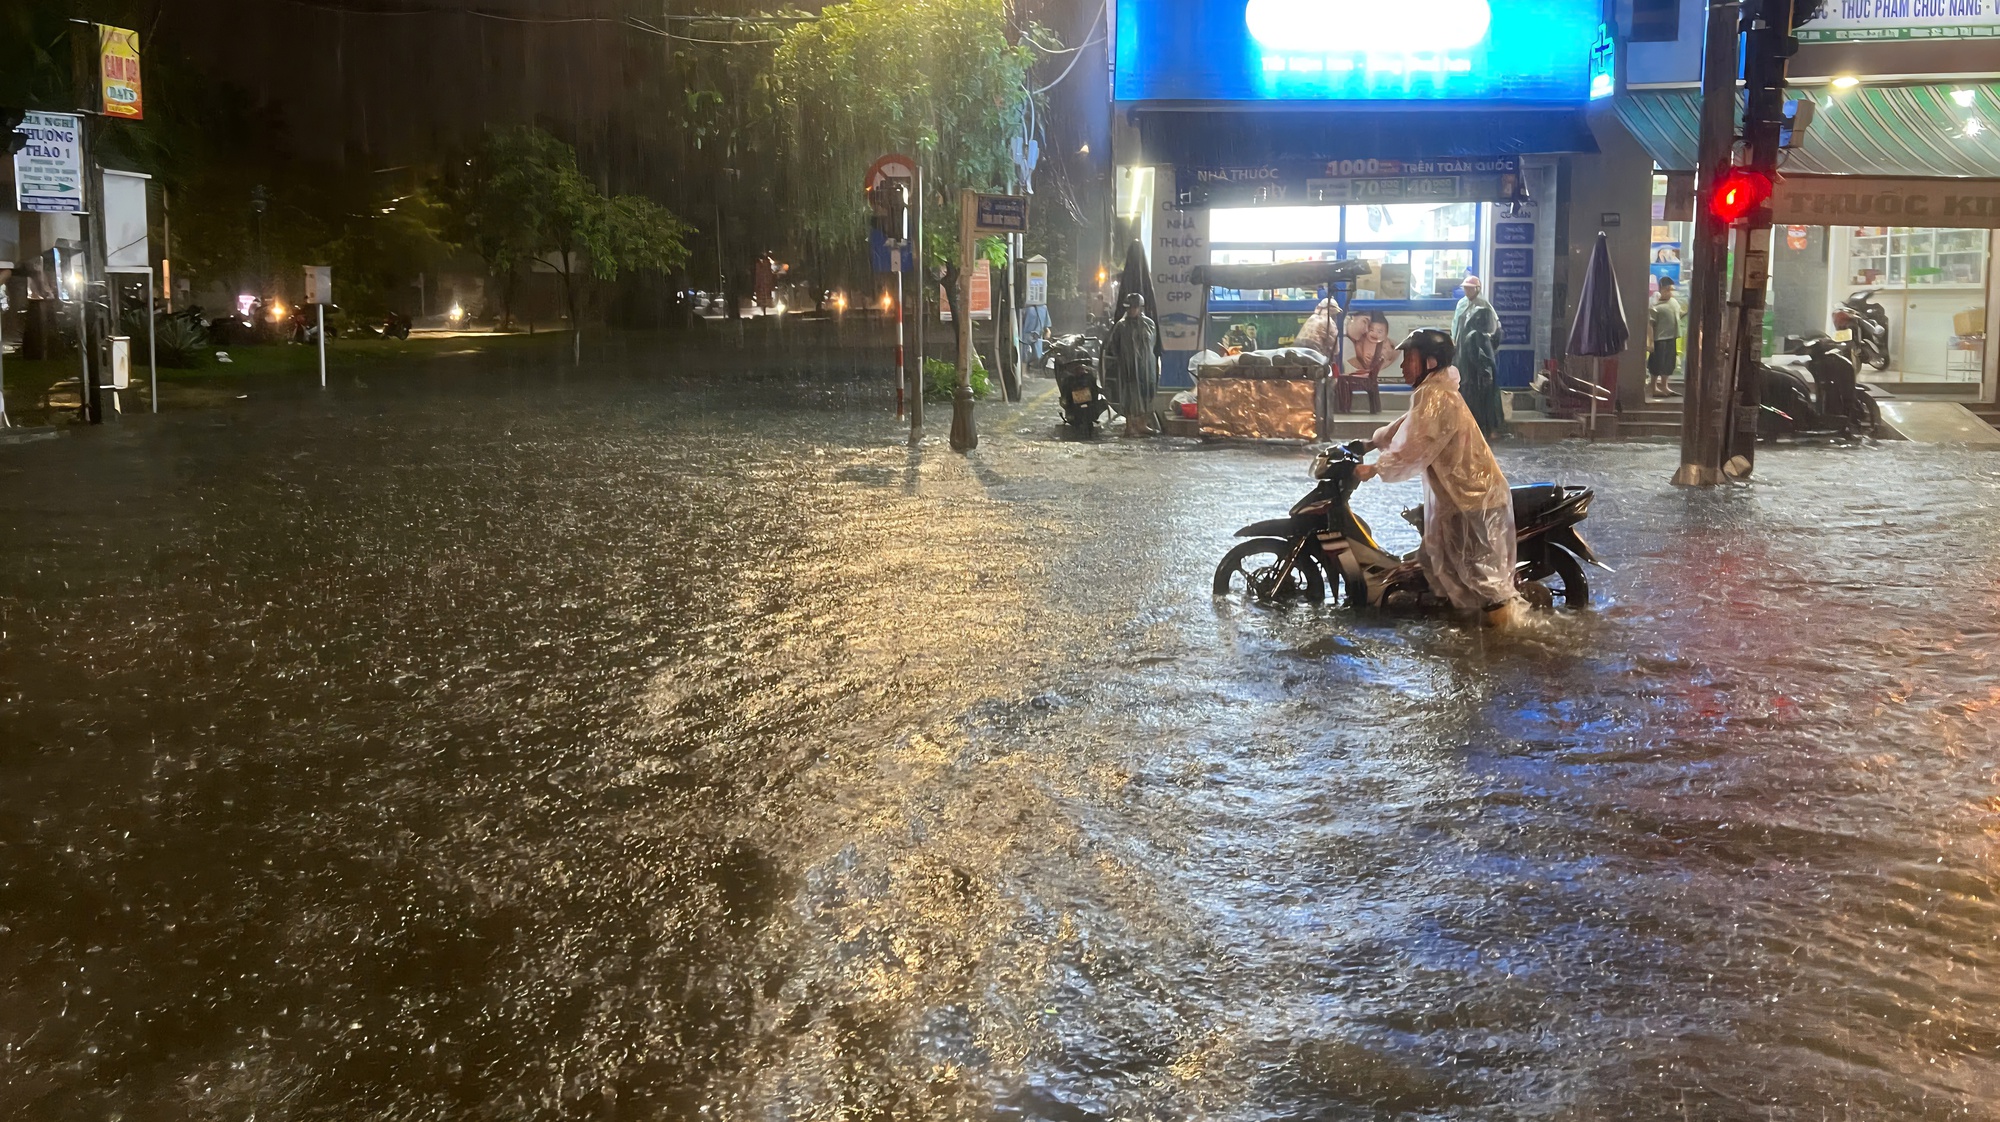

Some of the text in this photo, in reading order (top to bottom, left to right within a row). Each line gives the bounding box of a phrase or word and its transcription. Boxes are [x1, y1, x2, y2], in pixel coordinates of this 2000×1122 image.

[1197, 164, 1279, 182] NHÀ THUỐC
[1327, 158, 1379, 176] 1000
[1402, 161, 1434, 174] TRÊN
[1436, 159, 1473, 173] TOÀN
[1475, 158, 1514, 171] QUỐC
[1784, 188, 1930, 214] THUỐC
[1167, 216, 1196, 229] NHÀ
[1168, 255, 1192, 269] ĐẠT
[1166, 291, 1193, 302] GPP
